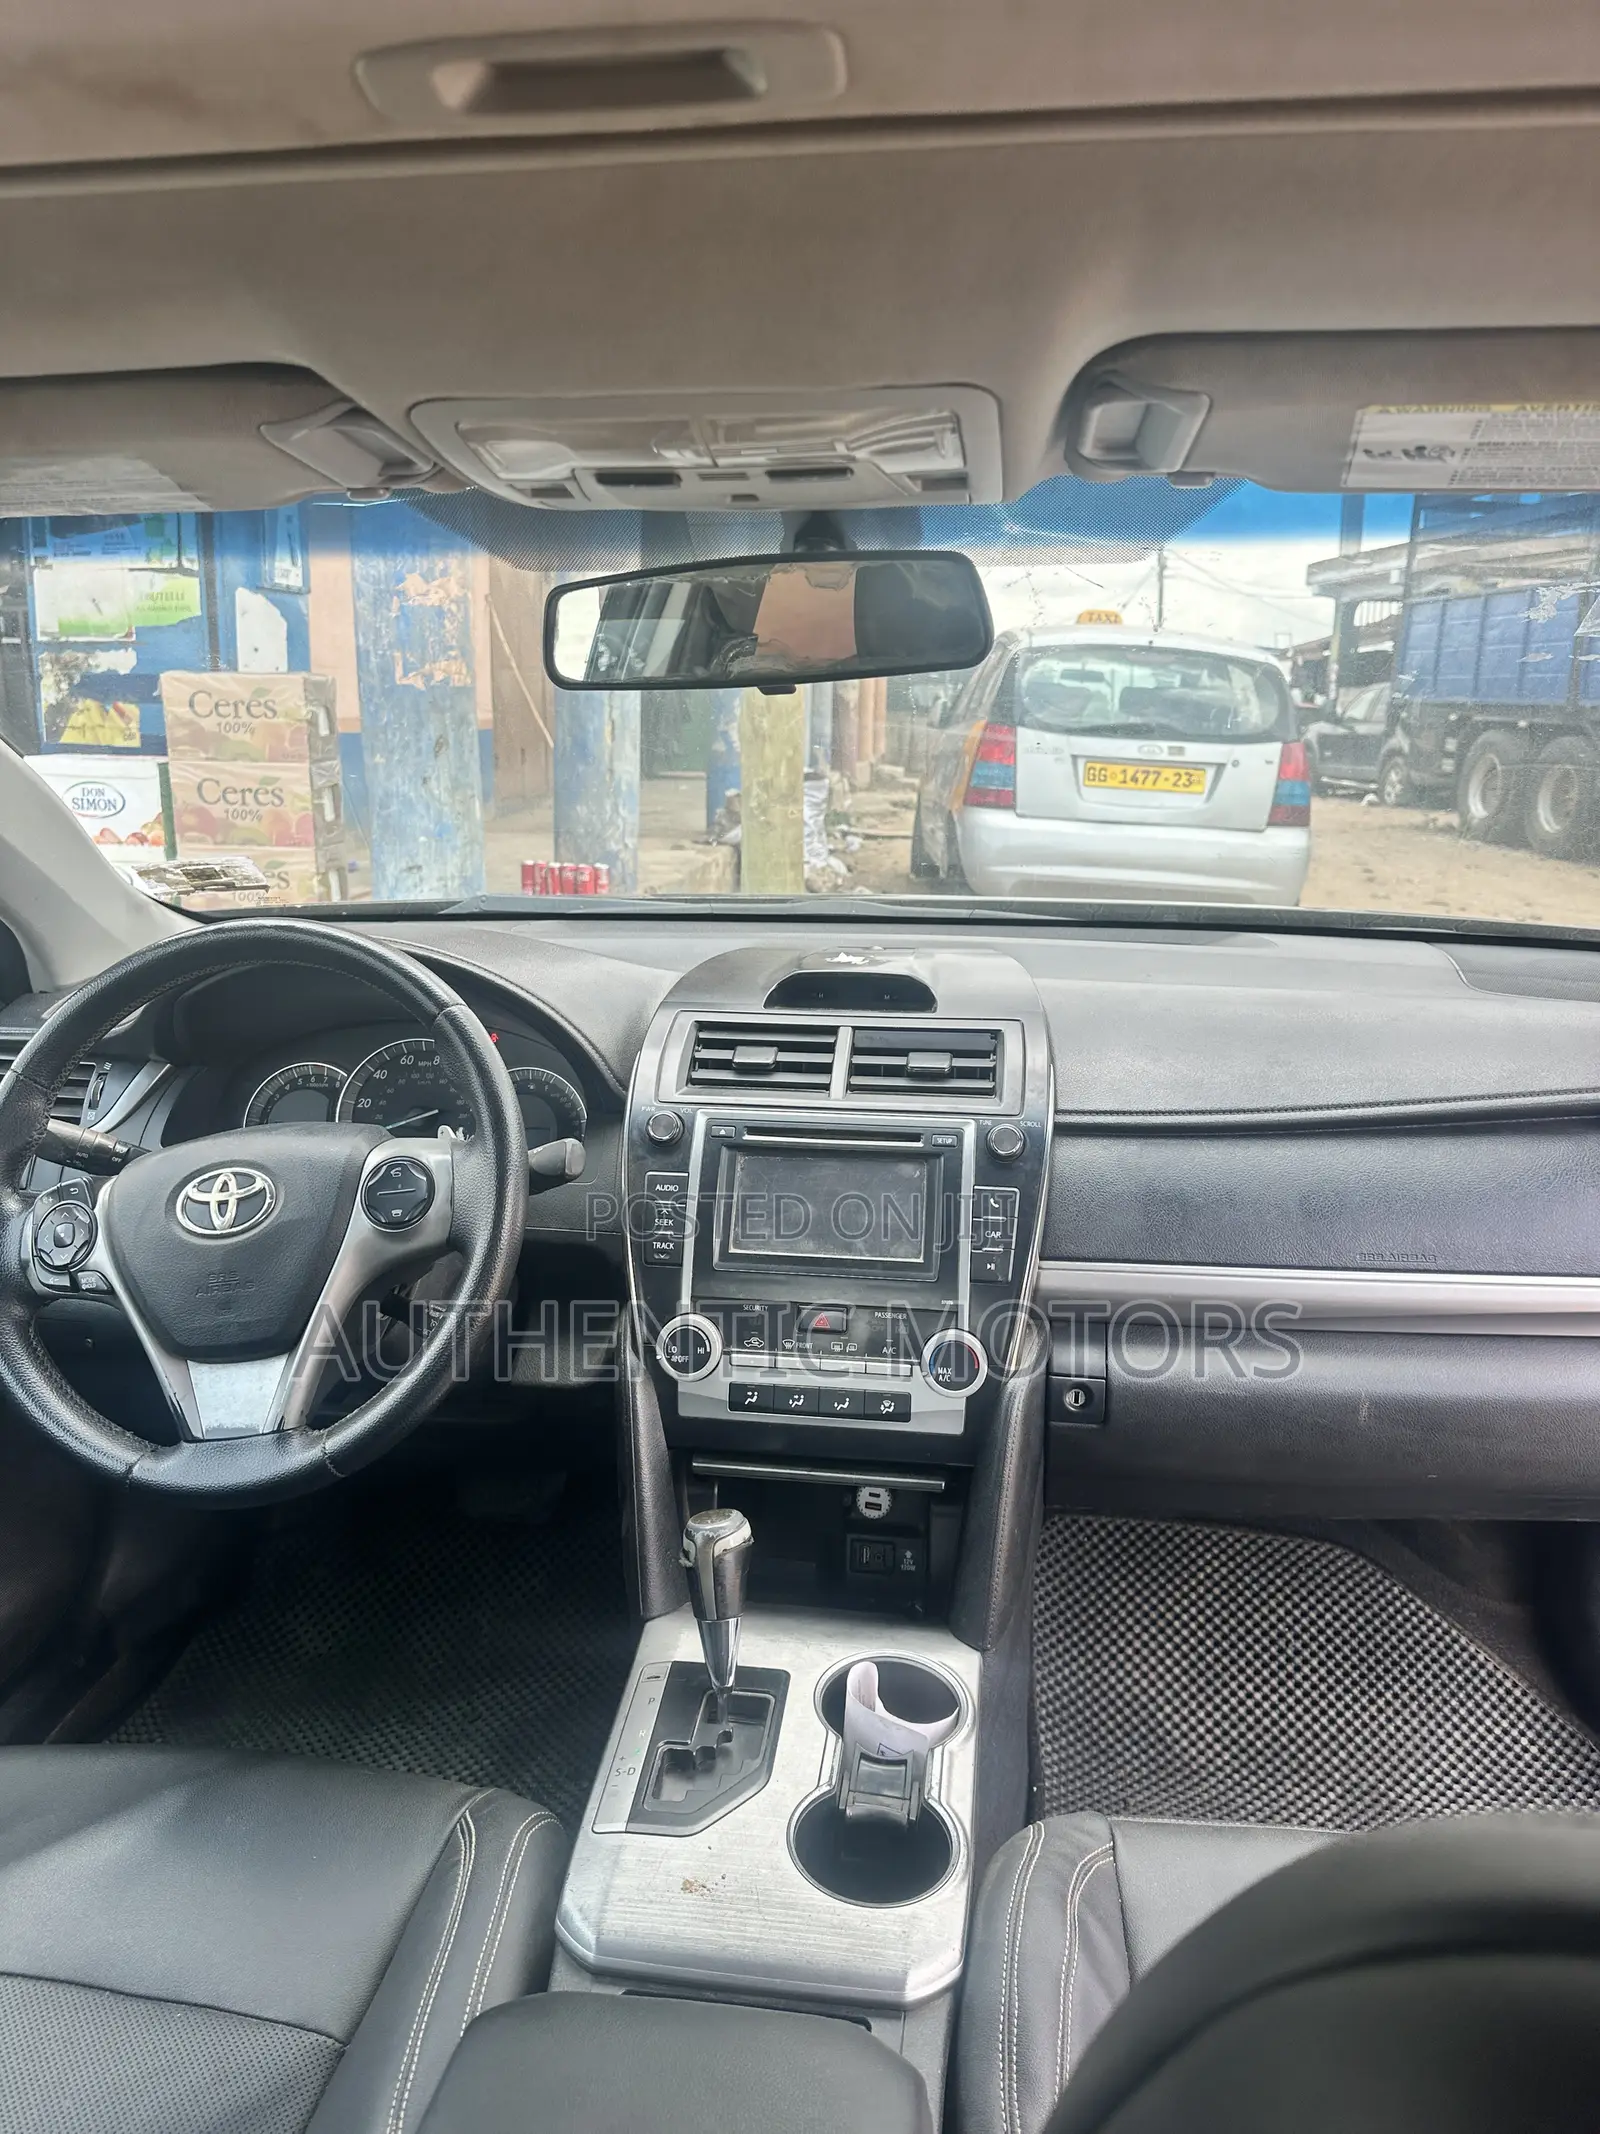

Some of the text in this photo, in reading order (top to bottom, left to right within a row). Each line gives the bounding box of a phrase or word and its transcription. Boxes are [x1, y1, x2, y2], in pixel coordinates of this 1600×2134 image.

[1088, 611, 1118, 625] TAXI
[188, 690, 278, 720] Ceres
[216, 721, 256, 737] 100%
[81, 787, 106, 798] DON
[196, 777, 285, 808] Ceres
[71, 798, 118, 812] SIMON
[223, 807, 264, 823] 100%
[400, 1055, 415, 1065] 60
[373, 1069, 388, 1080] 40
[357, 1098, 371, 1108] 20
[655, 1184, 679, 1192] AUDIO
[654, 1219, 674, 1227] SEEK
[985, 1230, 1002, 1239] CAR
[652, 1242, 675, 1250] TRACK
[874, 1311, 907, 1320] PASSENGER
[882, 1347, 897, 1355] A/C
[937, 1367, 952, 1375] MAX
